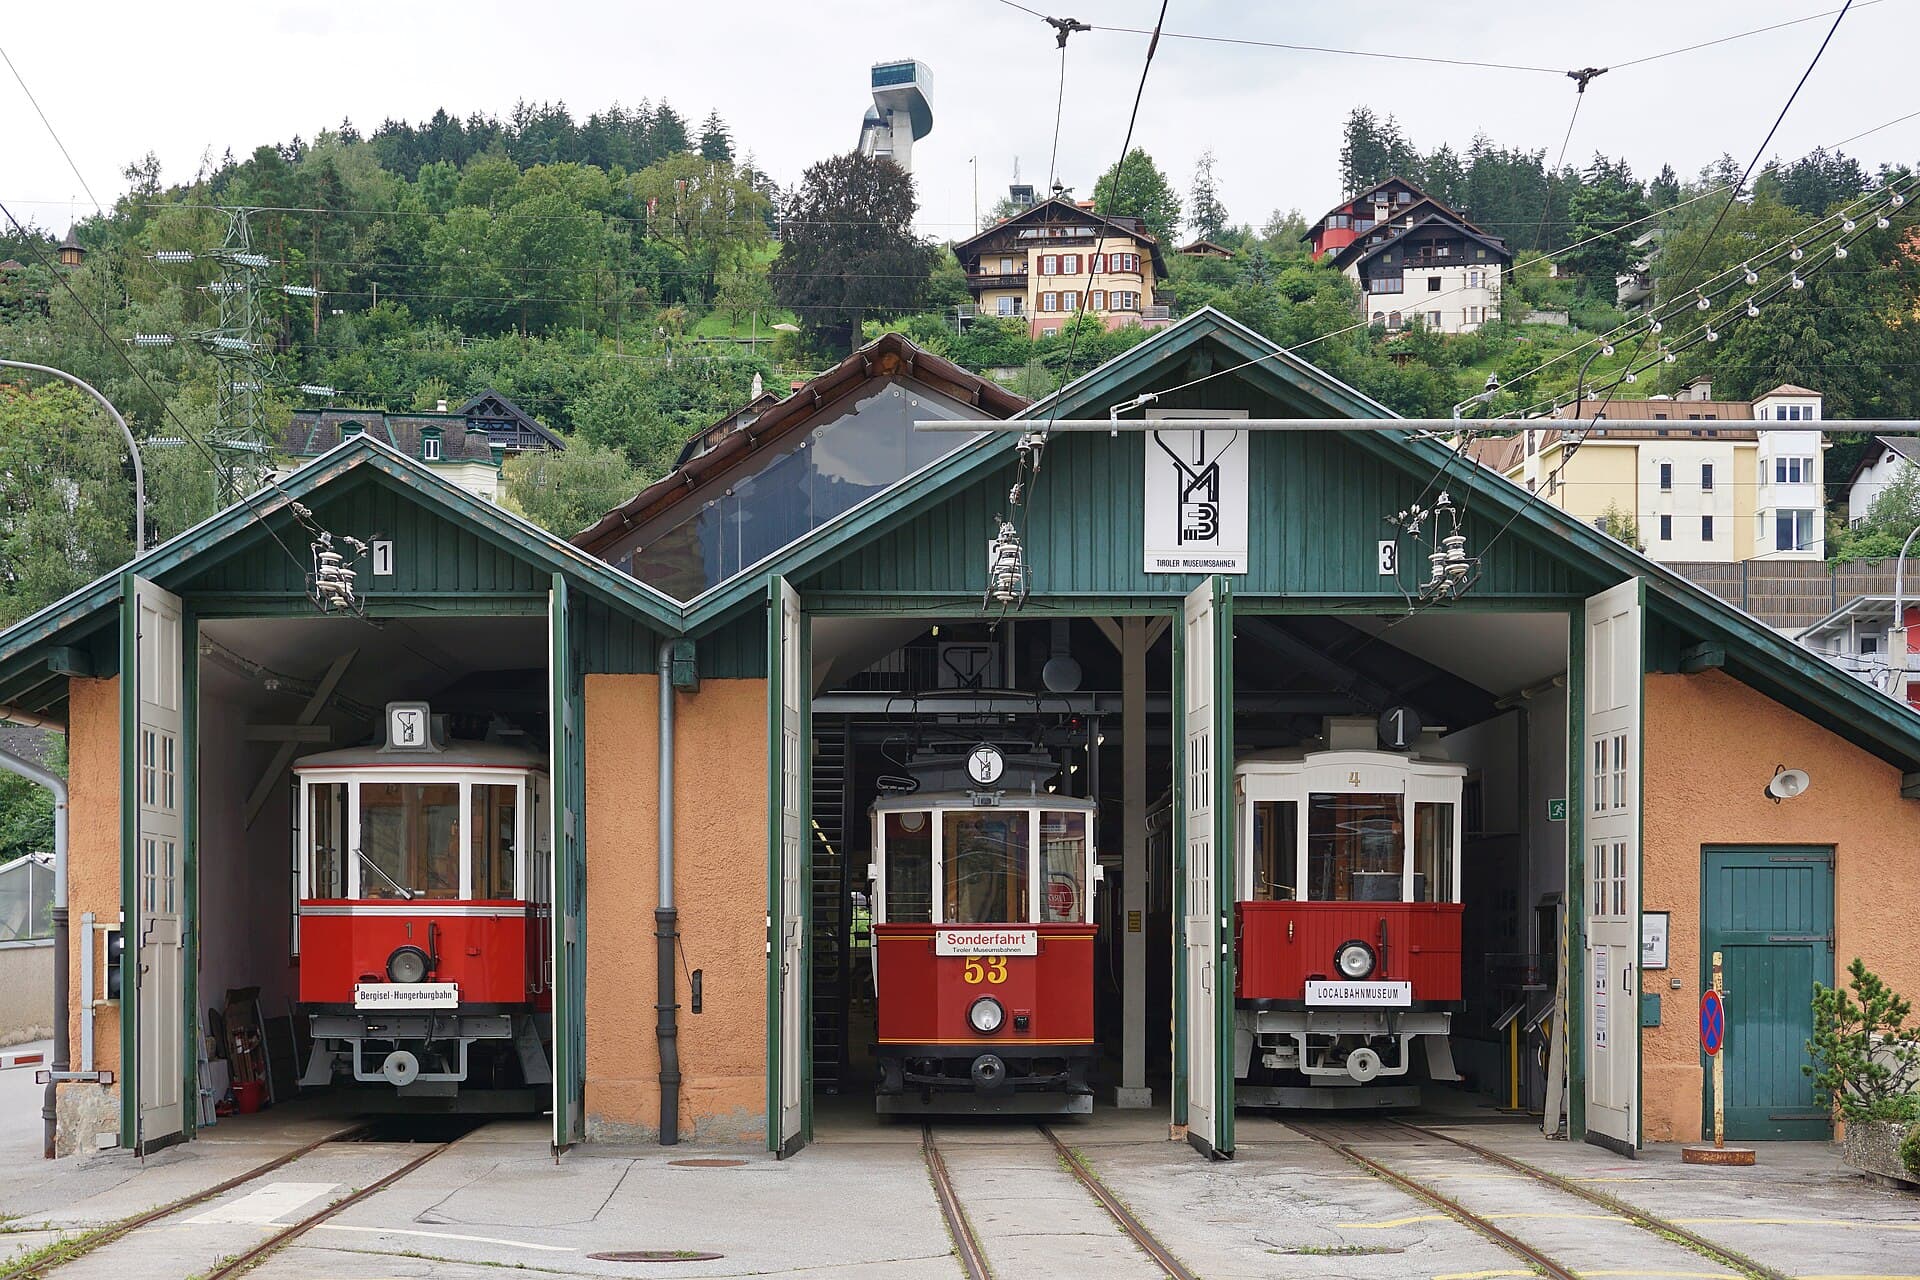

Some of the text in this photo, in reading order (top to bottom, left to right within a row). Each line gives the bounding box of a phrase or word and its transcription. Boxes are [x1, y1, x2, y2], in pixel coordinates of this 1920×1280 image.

[378, 544, 388, 571] 1
[1157, 559, 1236, 568] TIROLER MUSEUMSBAHNEN
[1383, 545, 1394, 570] 3
[1388, 709, 1405, 746] 1
[1348, 771, 1361, 788] 4
[405, 921, 413, 939] 1
[947, 933, 1026, 945] Sonderfahrt
[964, 956, 1008, 984] 53
[1318, 987, 1399, 999] LOCALBAHNMUSEUM
